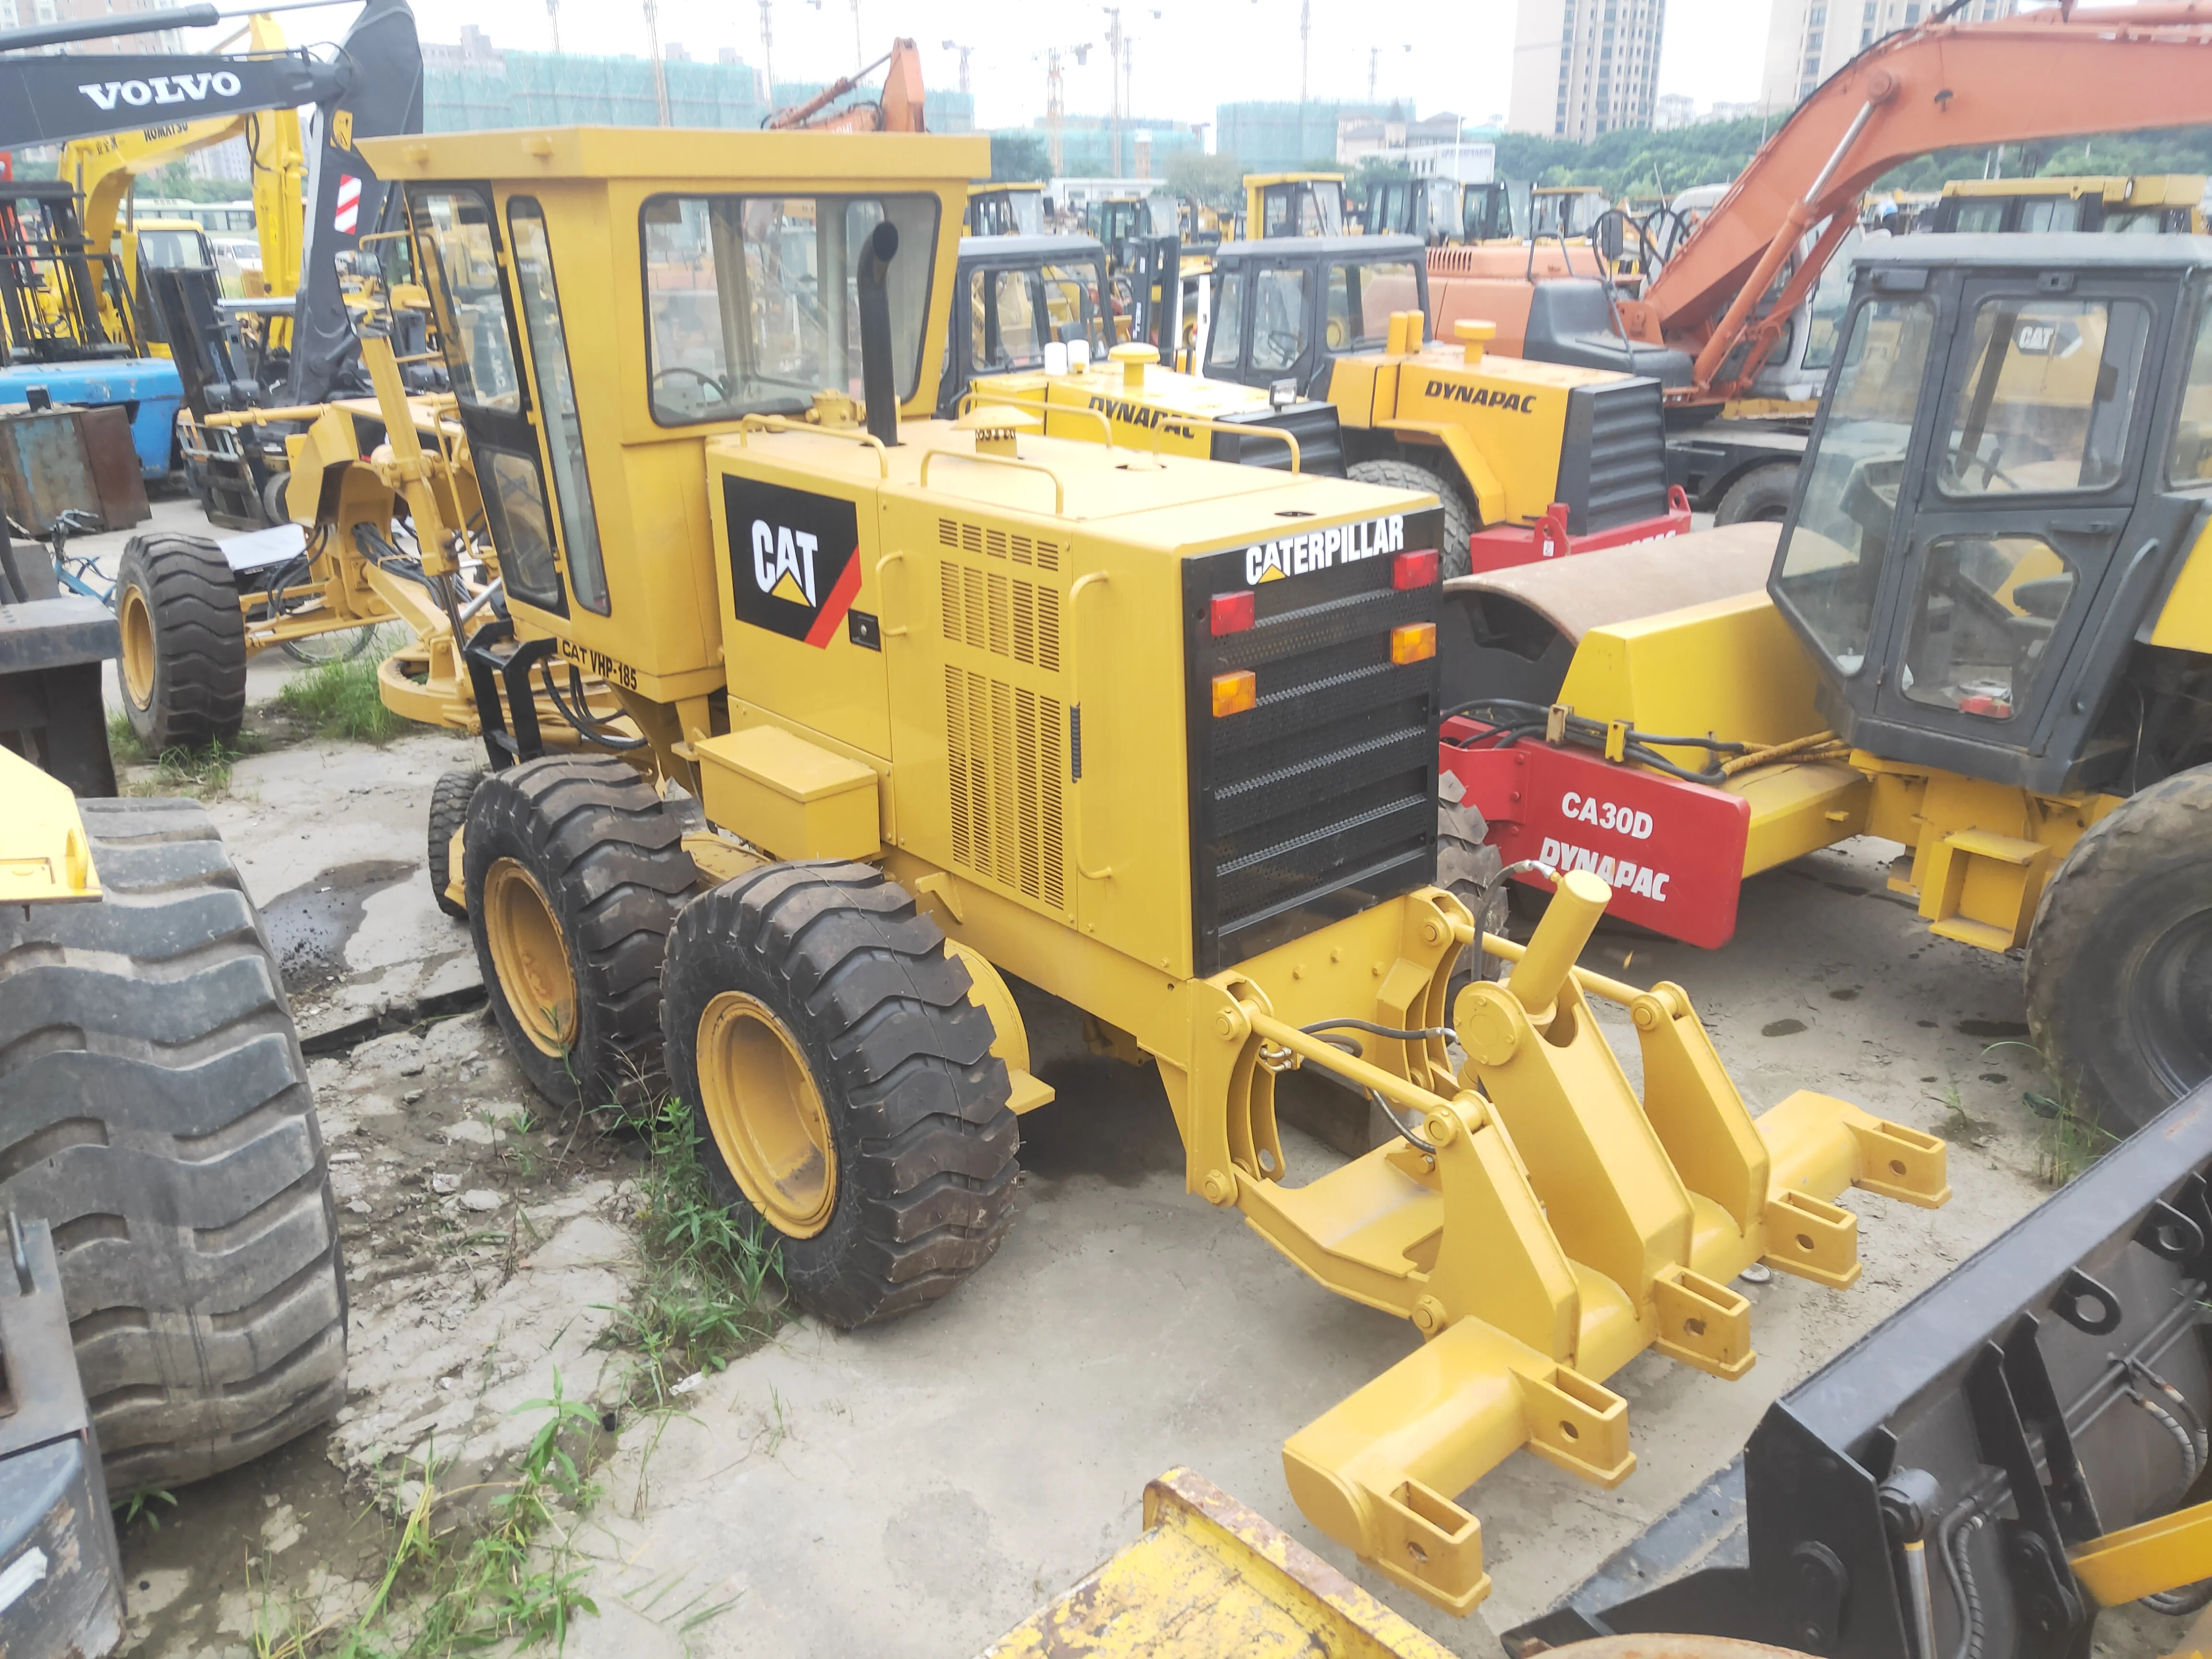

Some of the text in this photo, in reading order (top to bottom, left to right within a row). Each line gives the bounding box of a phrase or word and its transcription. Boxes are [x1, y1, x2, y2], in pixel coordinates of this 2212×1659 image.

[78, 71, 241, 110] VOLVO
[2019, 326, 2054, 349] CAT
[1425, 380, 1537, 413] DYNAPAC
[752, 519, 818, 608] CAT
[1246, 514, 1404, 585] CATERPILLAR
[563, 640, 637, 691] CAT VHP-185
[1562, 791, 1653, 839] CA30D
[1534, 837, 1670, 902] DYNAPAC
